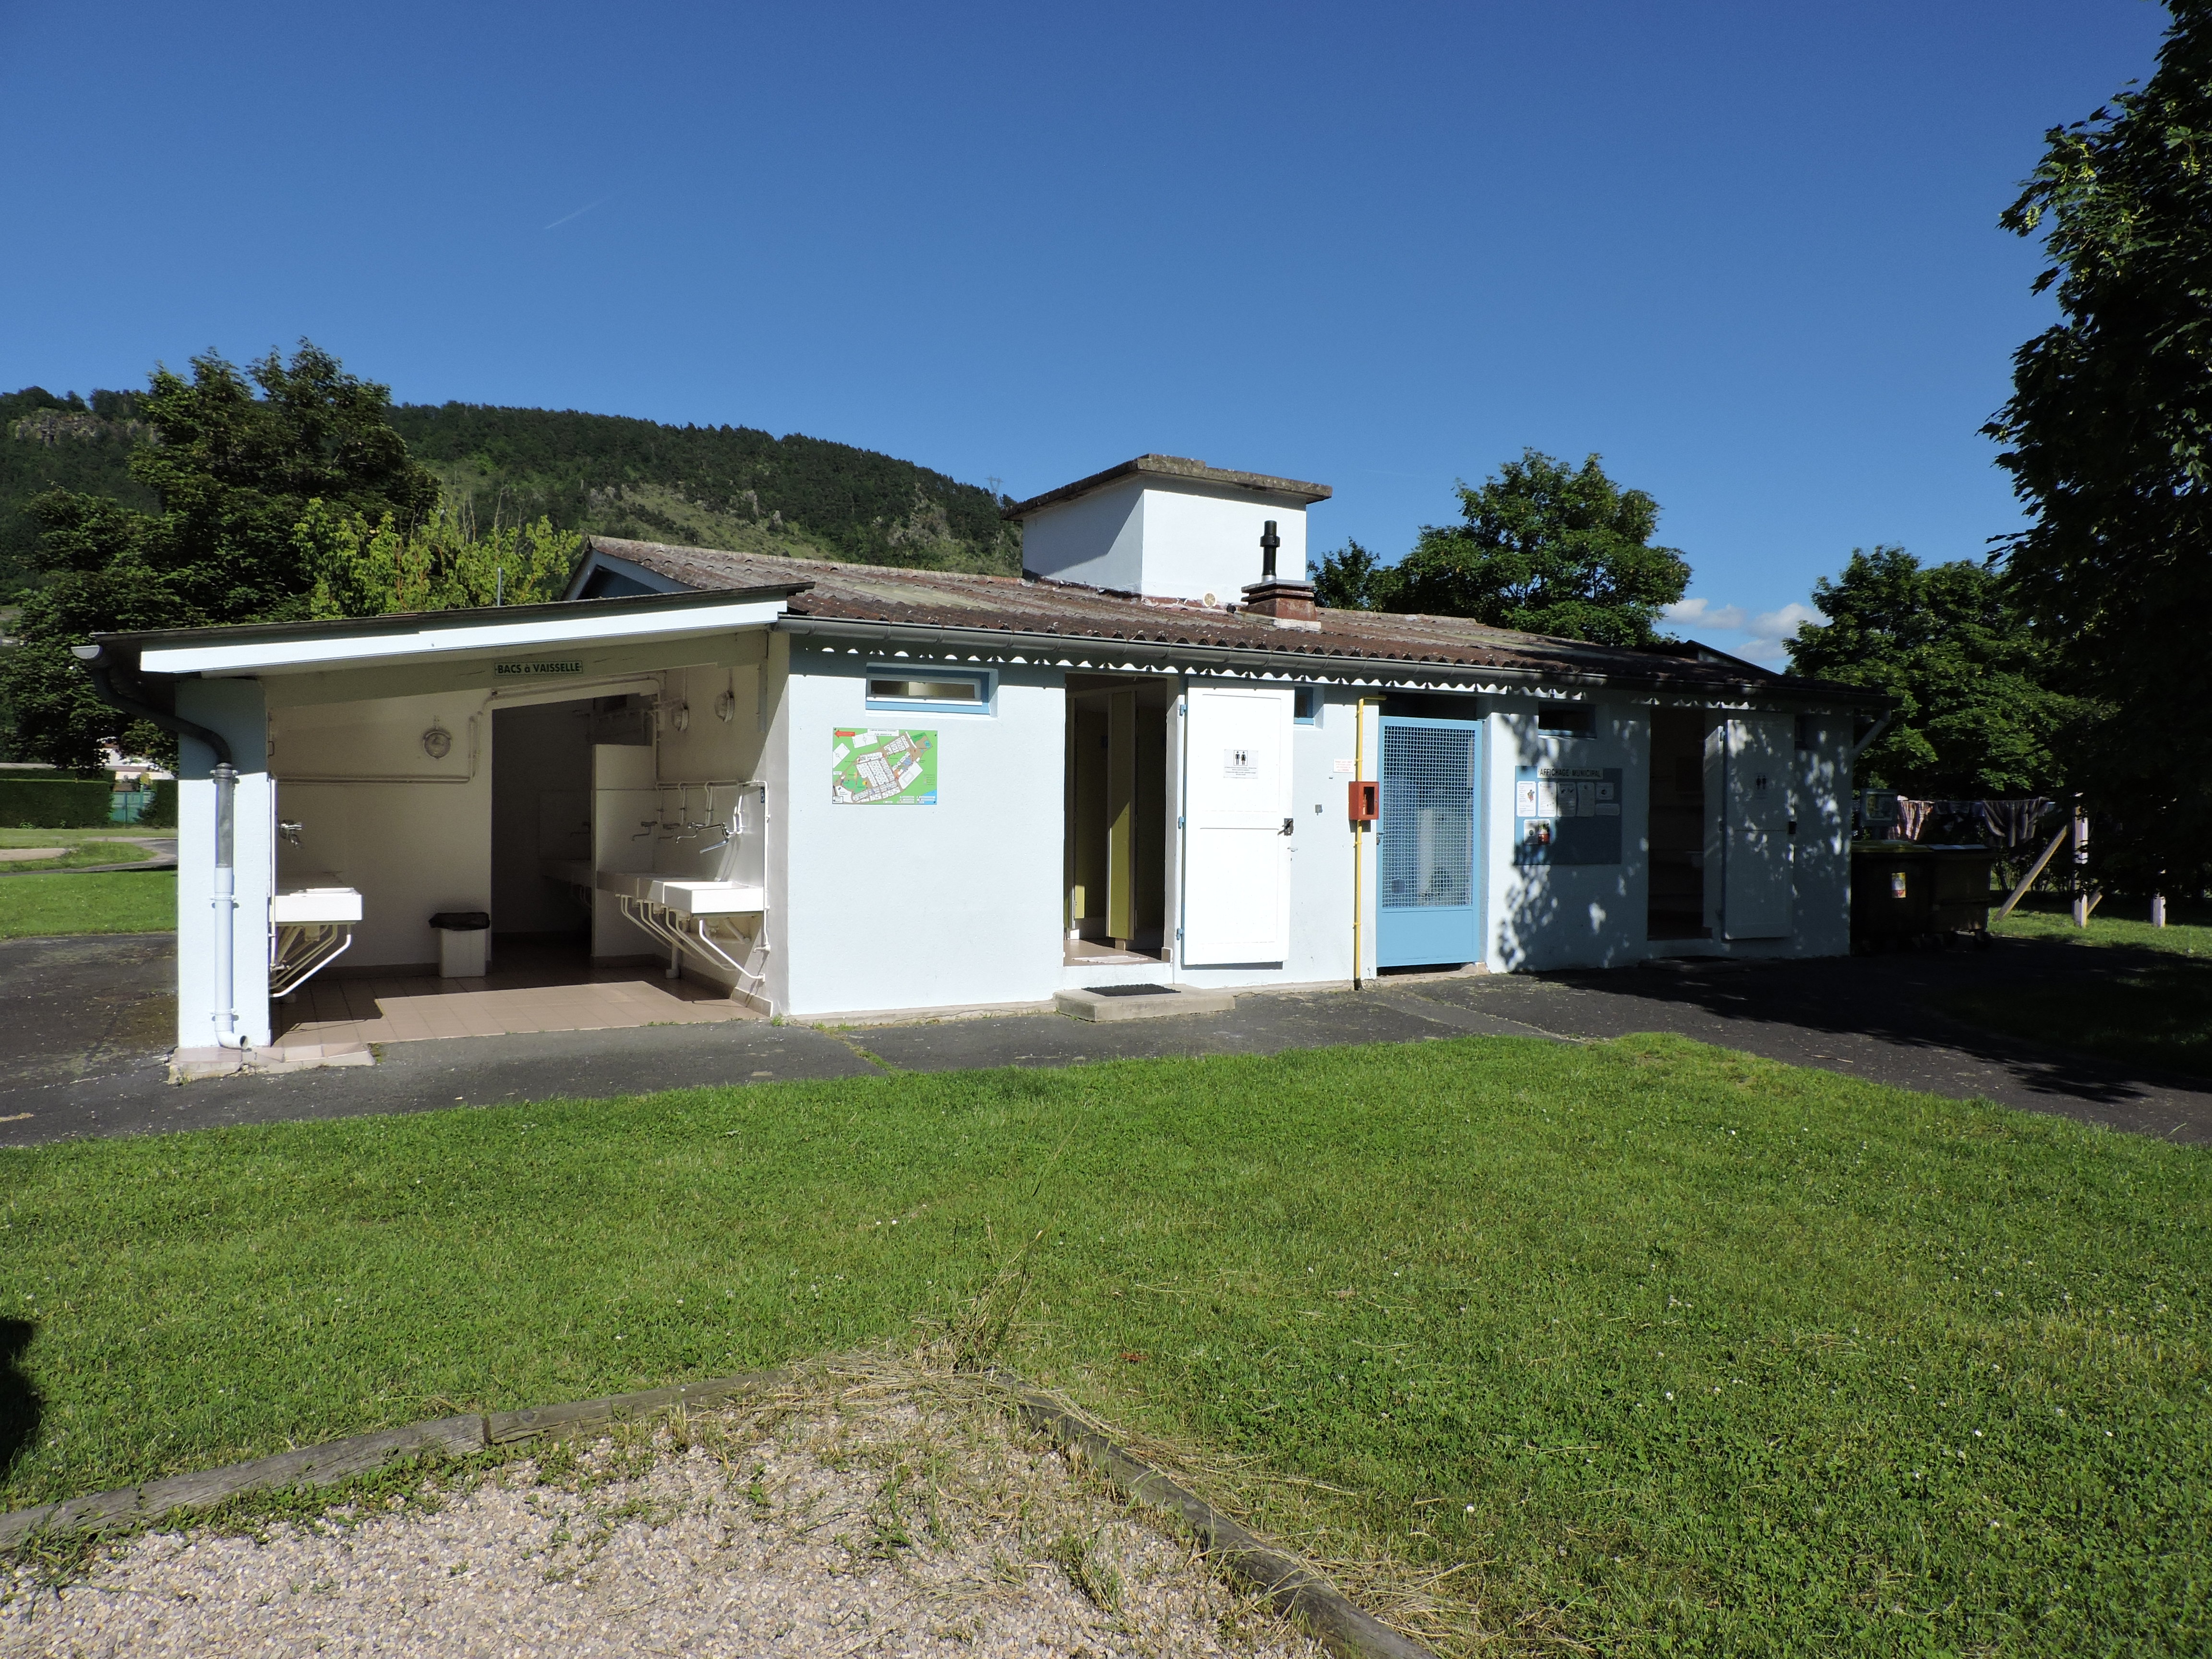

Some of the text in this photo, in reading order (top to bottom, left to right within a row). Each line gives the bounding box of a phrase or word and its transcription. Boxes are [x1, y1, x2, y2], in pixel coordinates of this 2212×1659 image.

[498, 662, 579, 673] BACS à VAISSELLE
[1539, 768, 1569, 776] AFFICHAGE
